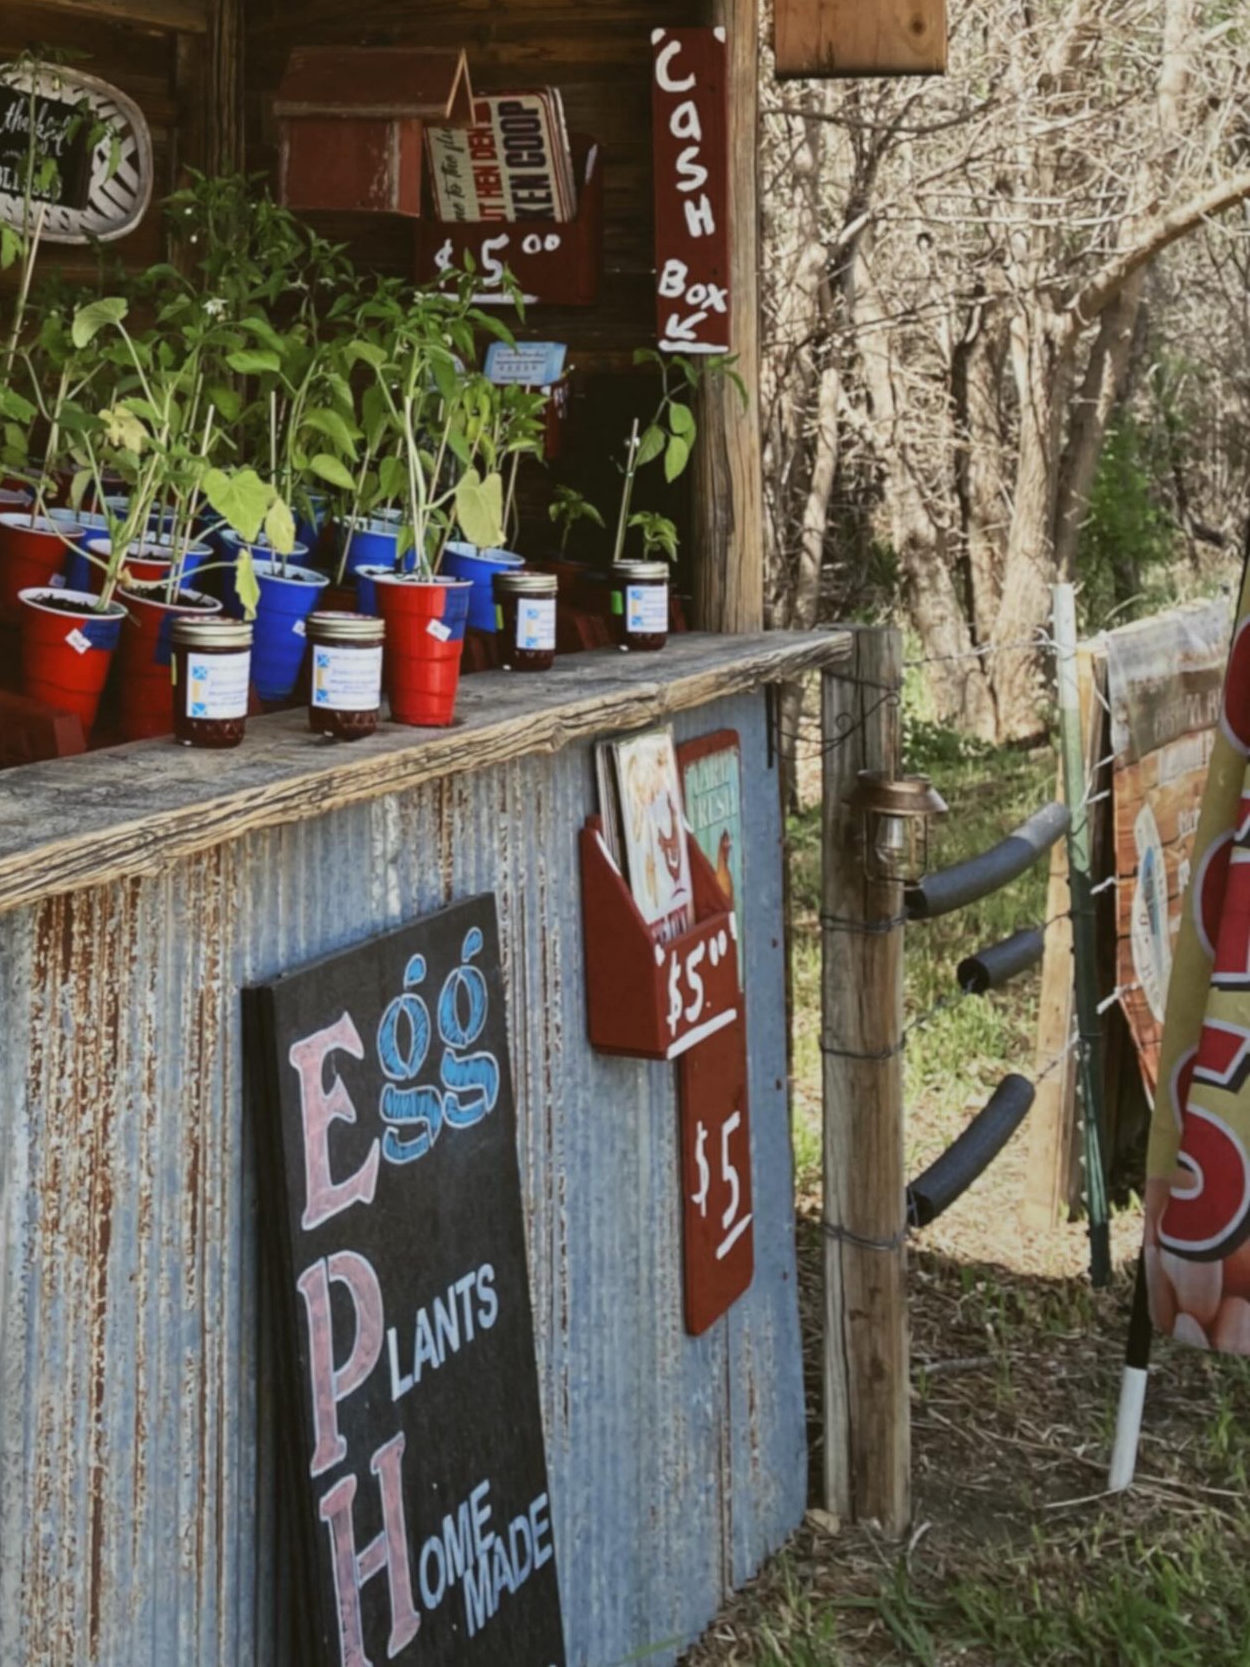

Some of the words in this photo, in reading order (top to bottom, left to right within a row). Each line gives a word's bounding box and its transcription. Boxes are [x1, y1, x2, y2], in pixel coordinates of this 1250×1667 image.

[466, 128, 498, 161] DEN
[498, 101, 546, 168] COOP
[472, 166, 503, 198] HEN
[297, 1249, 500, 1478] PLANTS
